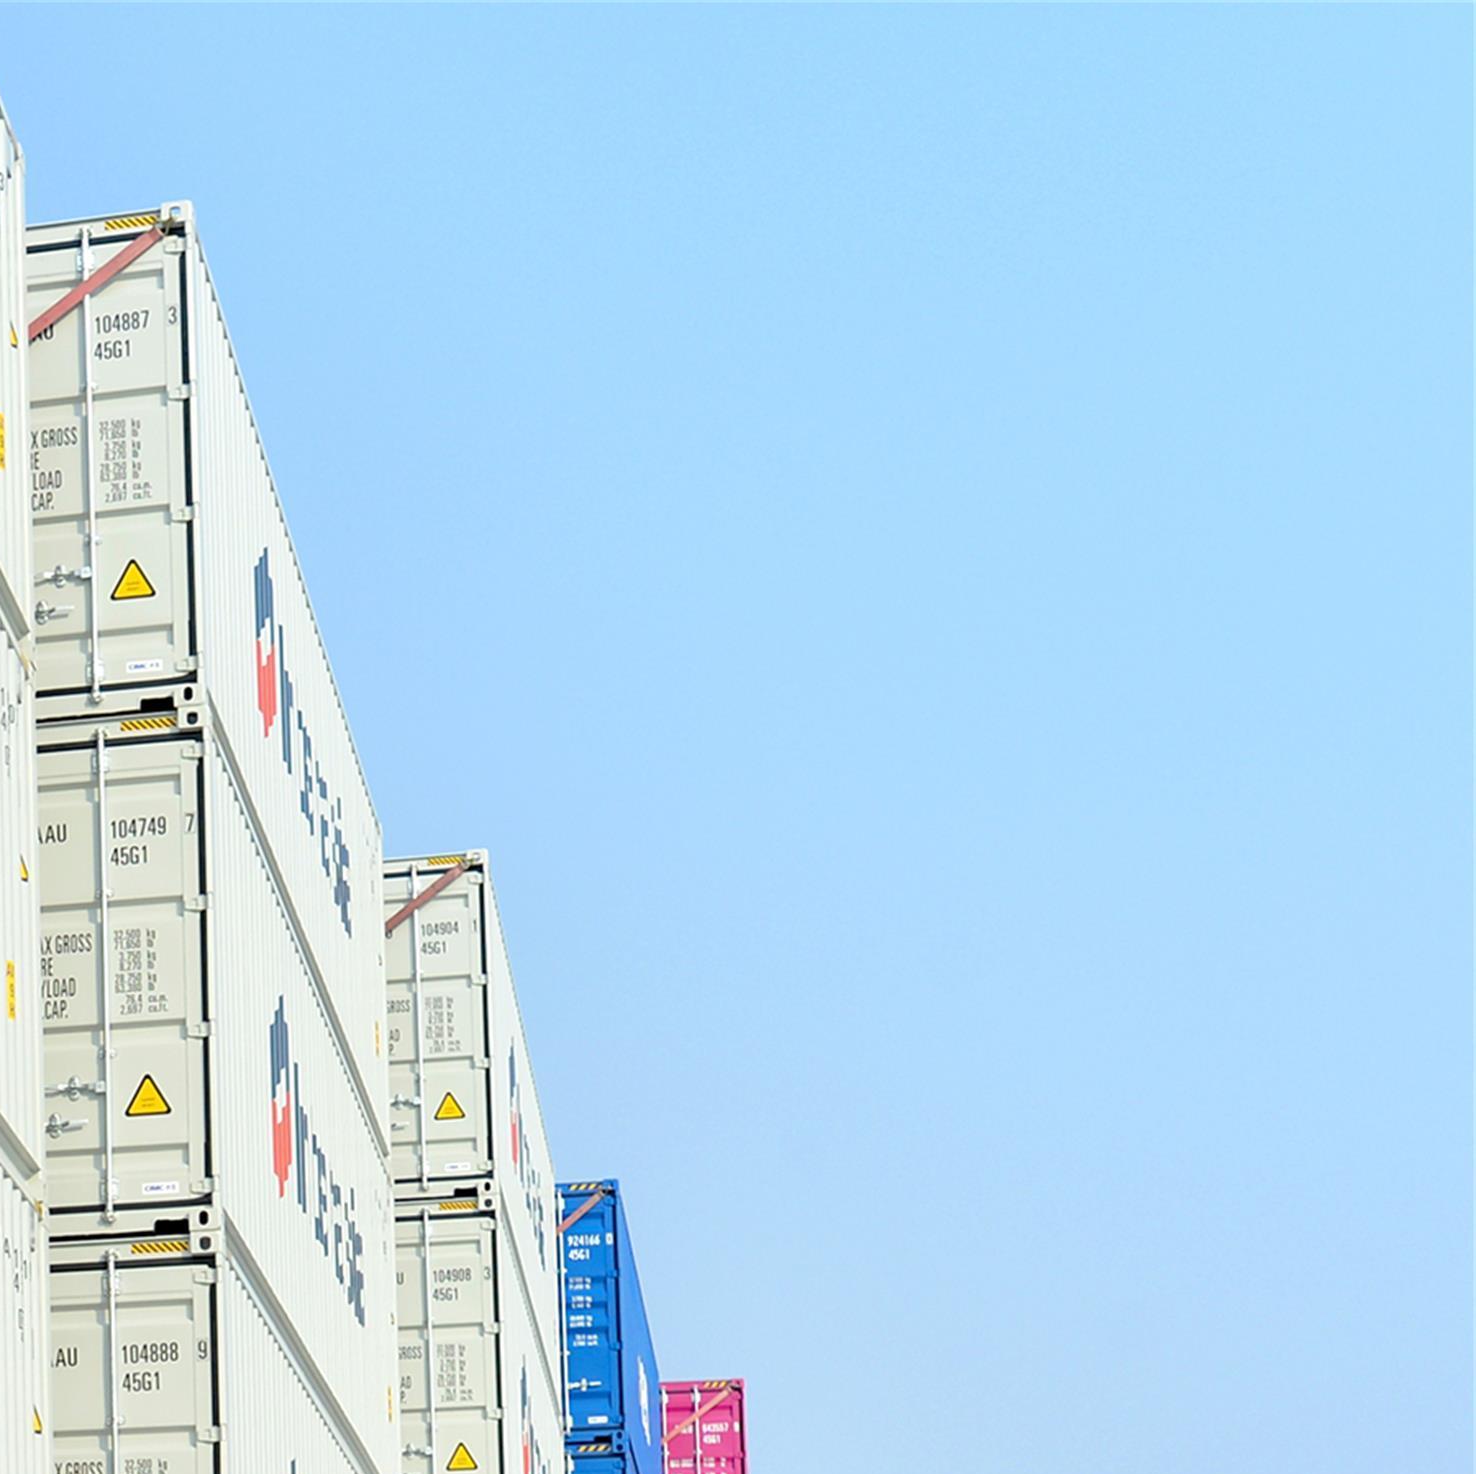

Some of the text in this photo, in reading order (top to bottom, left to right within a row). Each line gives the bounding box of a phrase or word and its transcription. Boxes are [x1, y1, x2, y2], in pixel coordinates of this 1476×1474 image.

[95, 310, 150, 334] 104887
[168, 306, 178, 325] 3
[94, 340, 131, 361] 45G1
[41, 427, 78, 449] GROSS
[110, 816, 167, 839] 104749
[184, 813, 195, 833] 7
[110, 845, 148, 866] 45G1
[421, 921, 460, 936] 104904
[55, 933, 93, 955] GROSS
[420, 942, 447, 955] 45G1
[432, 1287, 459, 1301] 45G1
[122, 1341, 179, 1364] 104888
[197, 1340, 208, 1360] 9
[122, 1371, 161, 1392] 45G1
